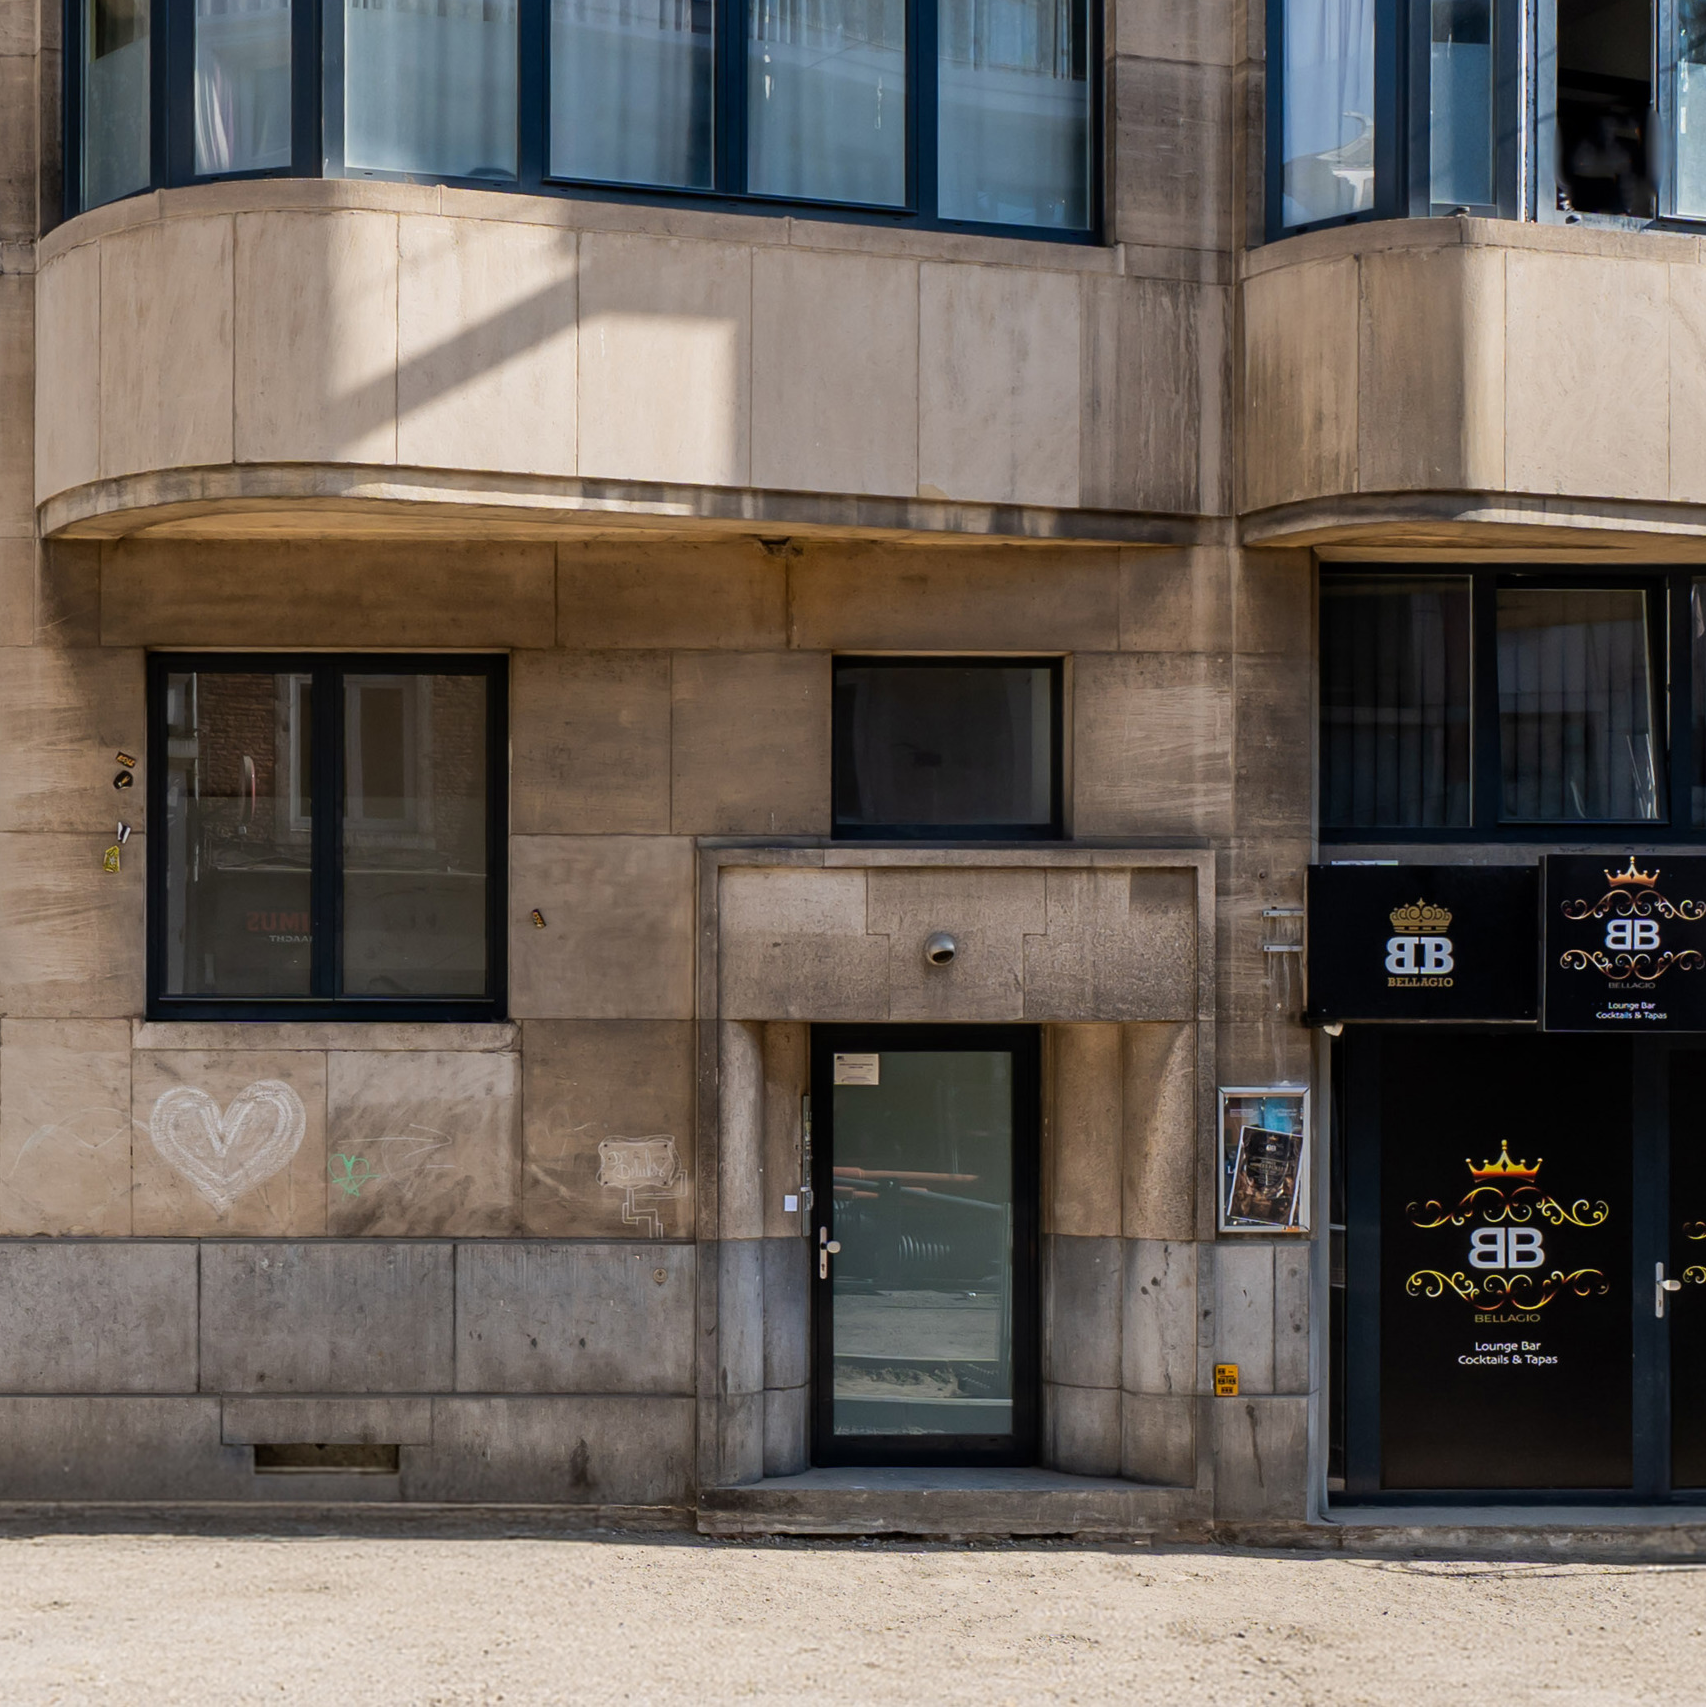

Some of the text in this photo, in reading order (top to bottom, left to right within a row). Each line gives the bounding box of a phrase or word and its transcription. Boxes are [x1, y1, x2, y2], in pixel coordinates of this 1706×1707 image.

[1387, 977, 1454, 988] BELLAGIO
[1608, 981, 1656, 990] BELLAGIO
[1608, 1001, 1656, 1011] Lounge Bar
[1595, 1011, 1633, 1020] Cocktails
[1643, 1011, 1668, 1021] Tapas
[1474, 1313, 1541, 1323] BELLAGIO
[1475, 1341, 1542, 1353] Lounge Bar
[1458, 1354, 1558, 1366] Cocktails & Tapas
